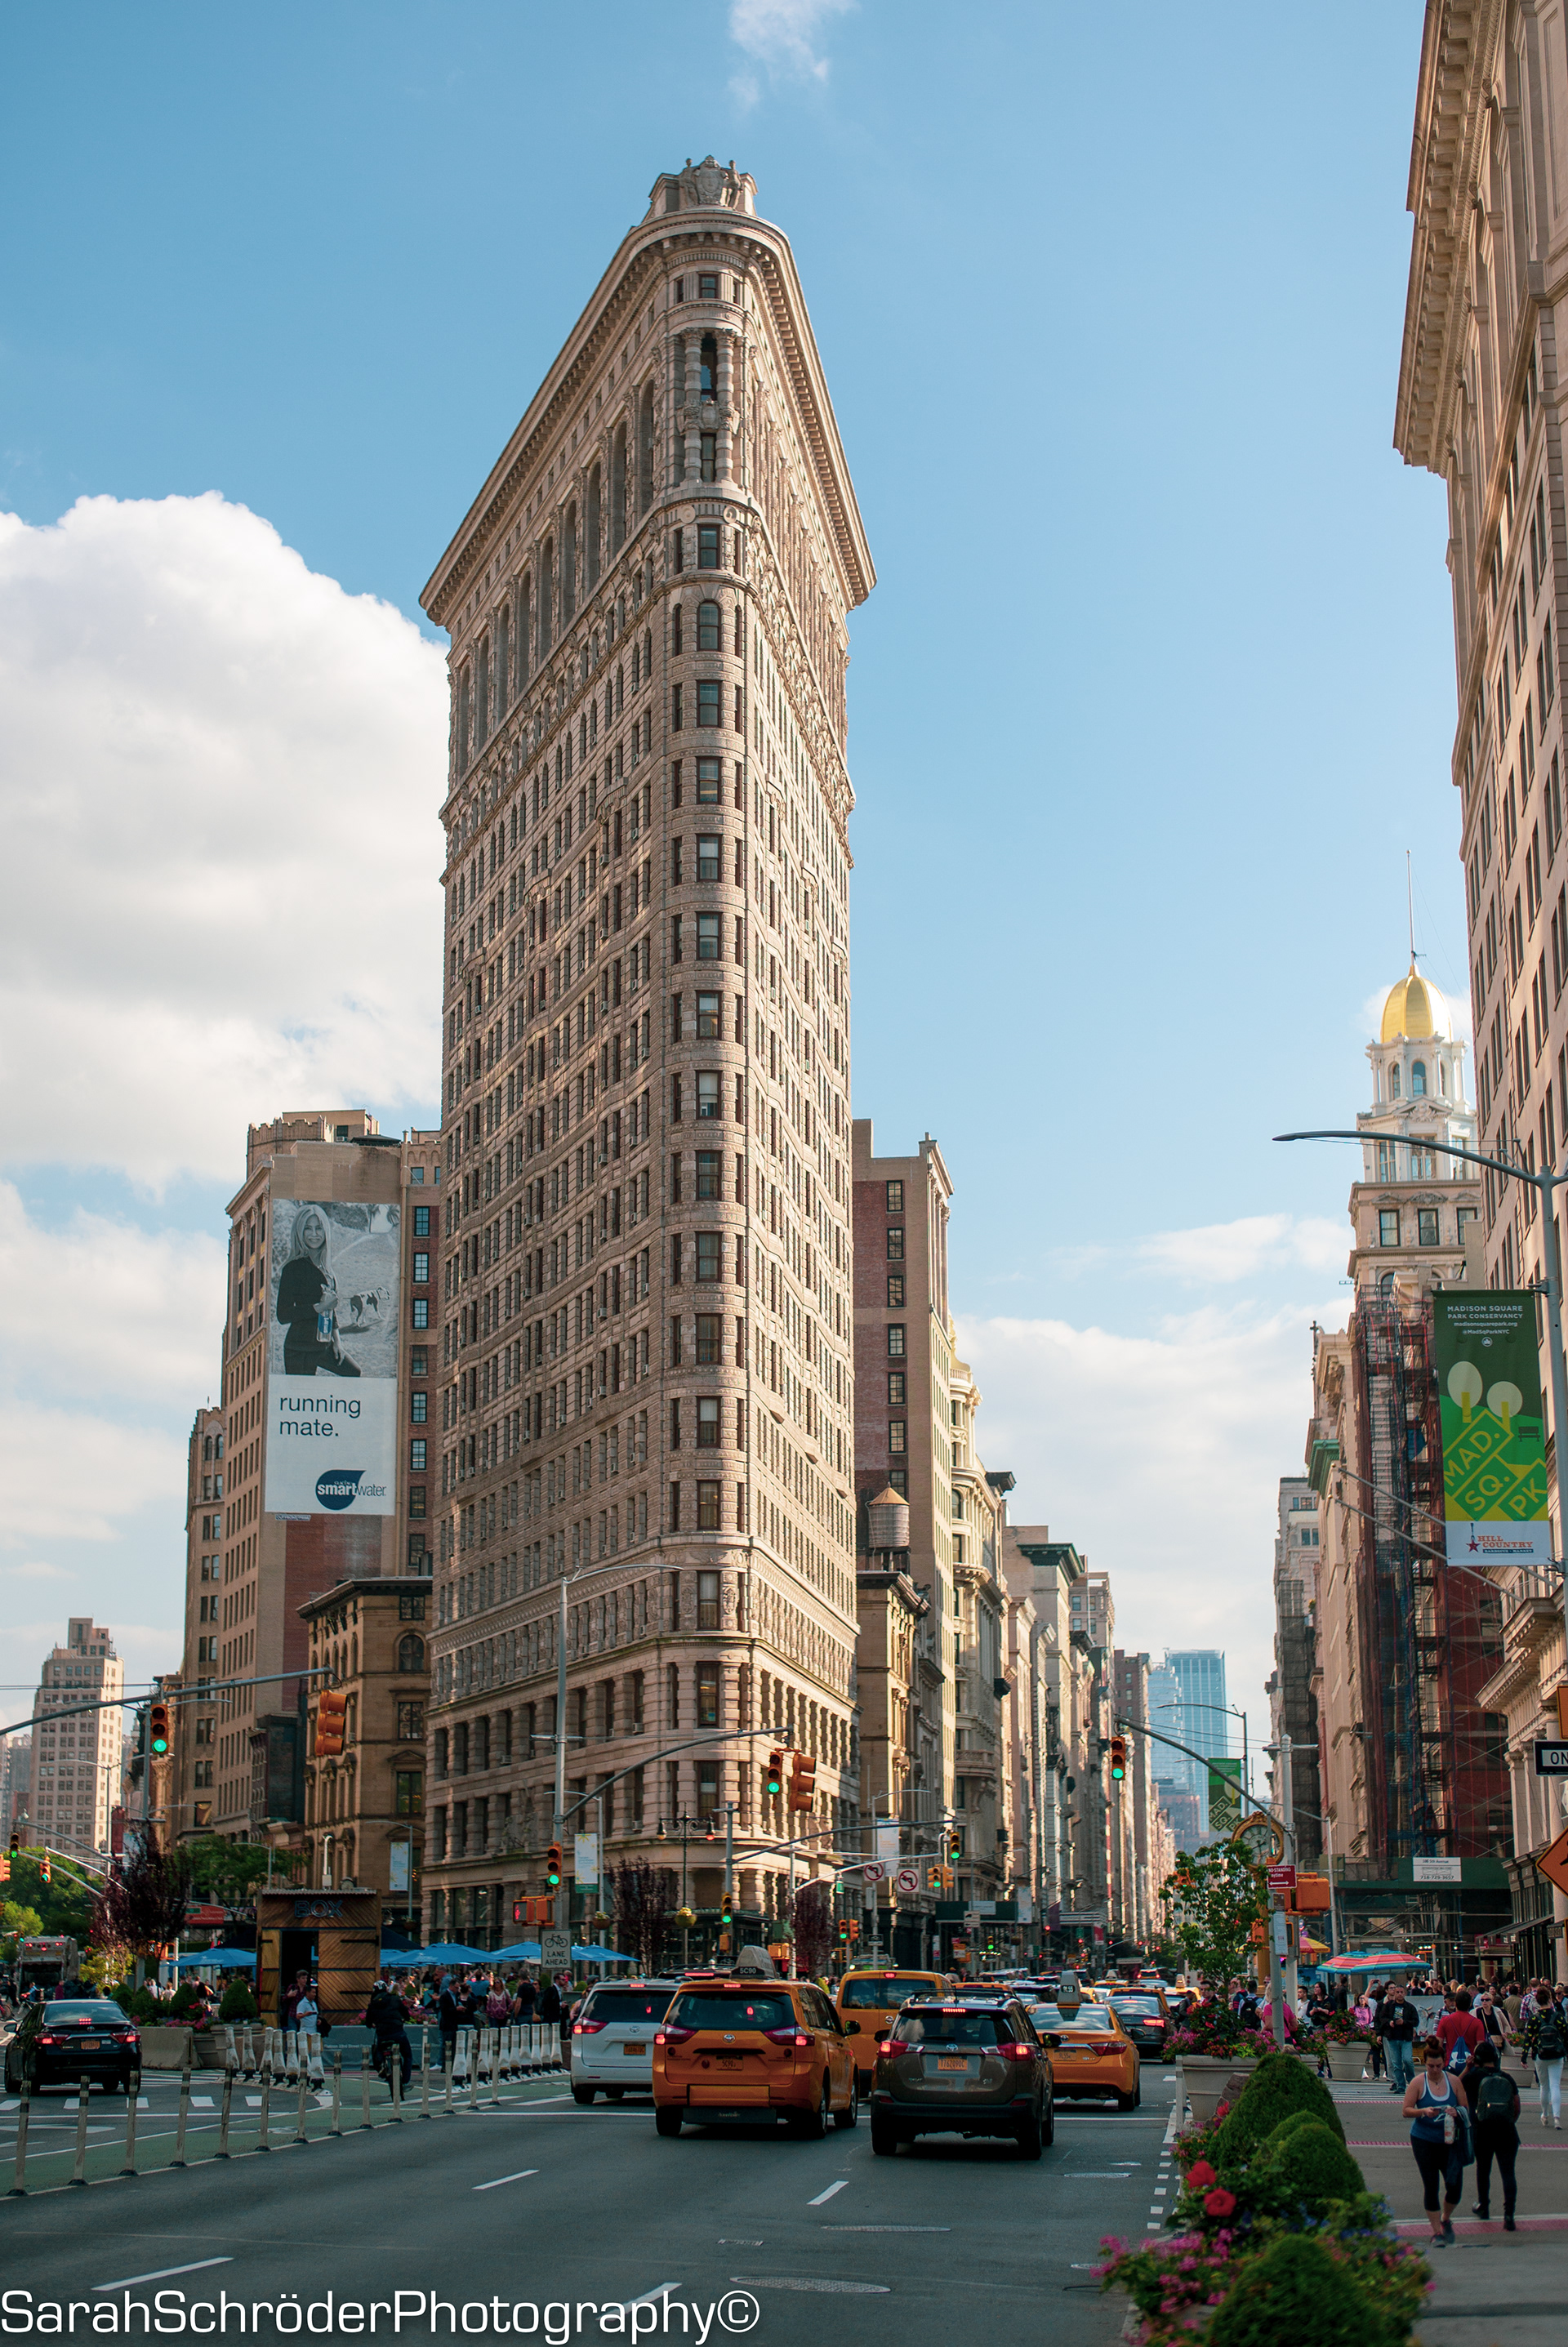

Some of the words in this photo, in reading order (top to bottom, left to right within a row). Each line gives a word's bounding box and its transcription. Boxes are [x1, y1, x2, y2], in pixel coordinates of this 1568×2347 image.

[279, 1395, 361, 1418] running
[279, 1419, 339, 1436] mate.
[1444, 1430, 1500, 1487] MAD.
[317, 1482, 387, 1496] smartwater
[1464, 1474, 1511, 1511] SQ.
[1508, 1477, 1548, 1517] PK
[295, 1899, 343, 1917] BOX
